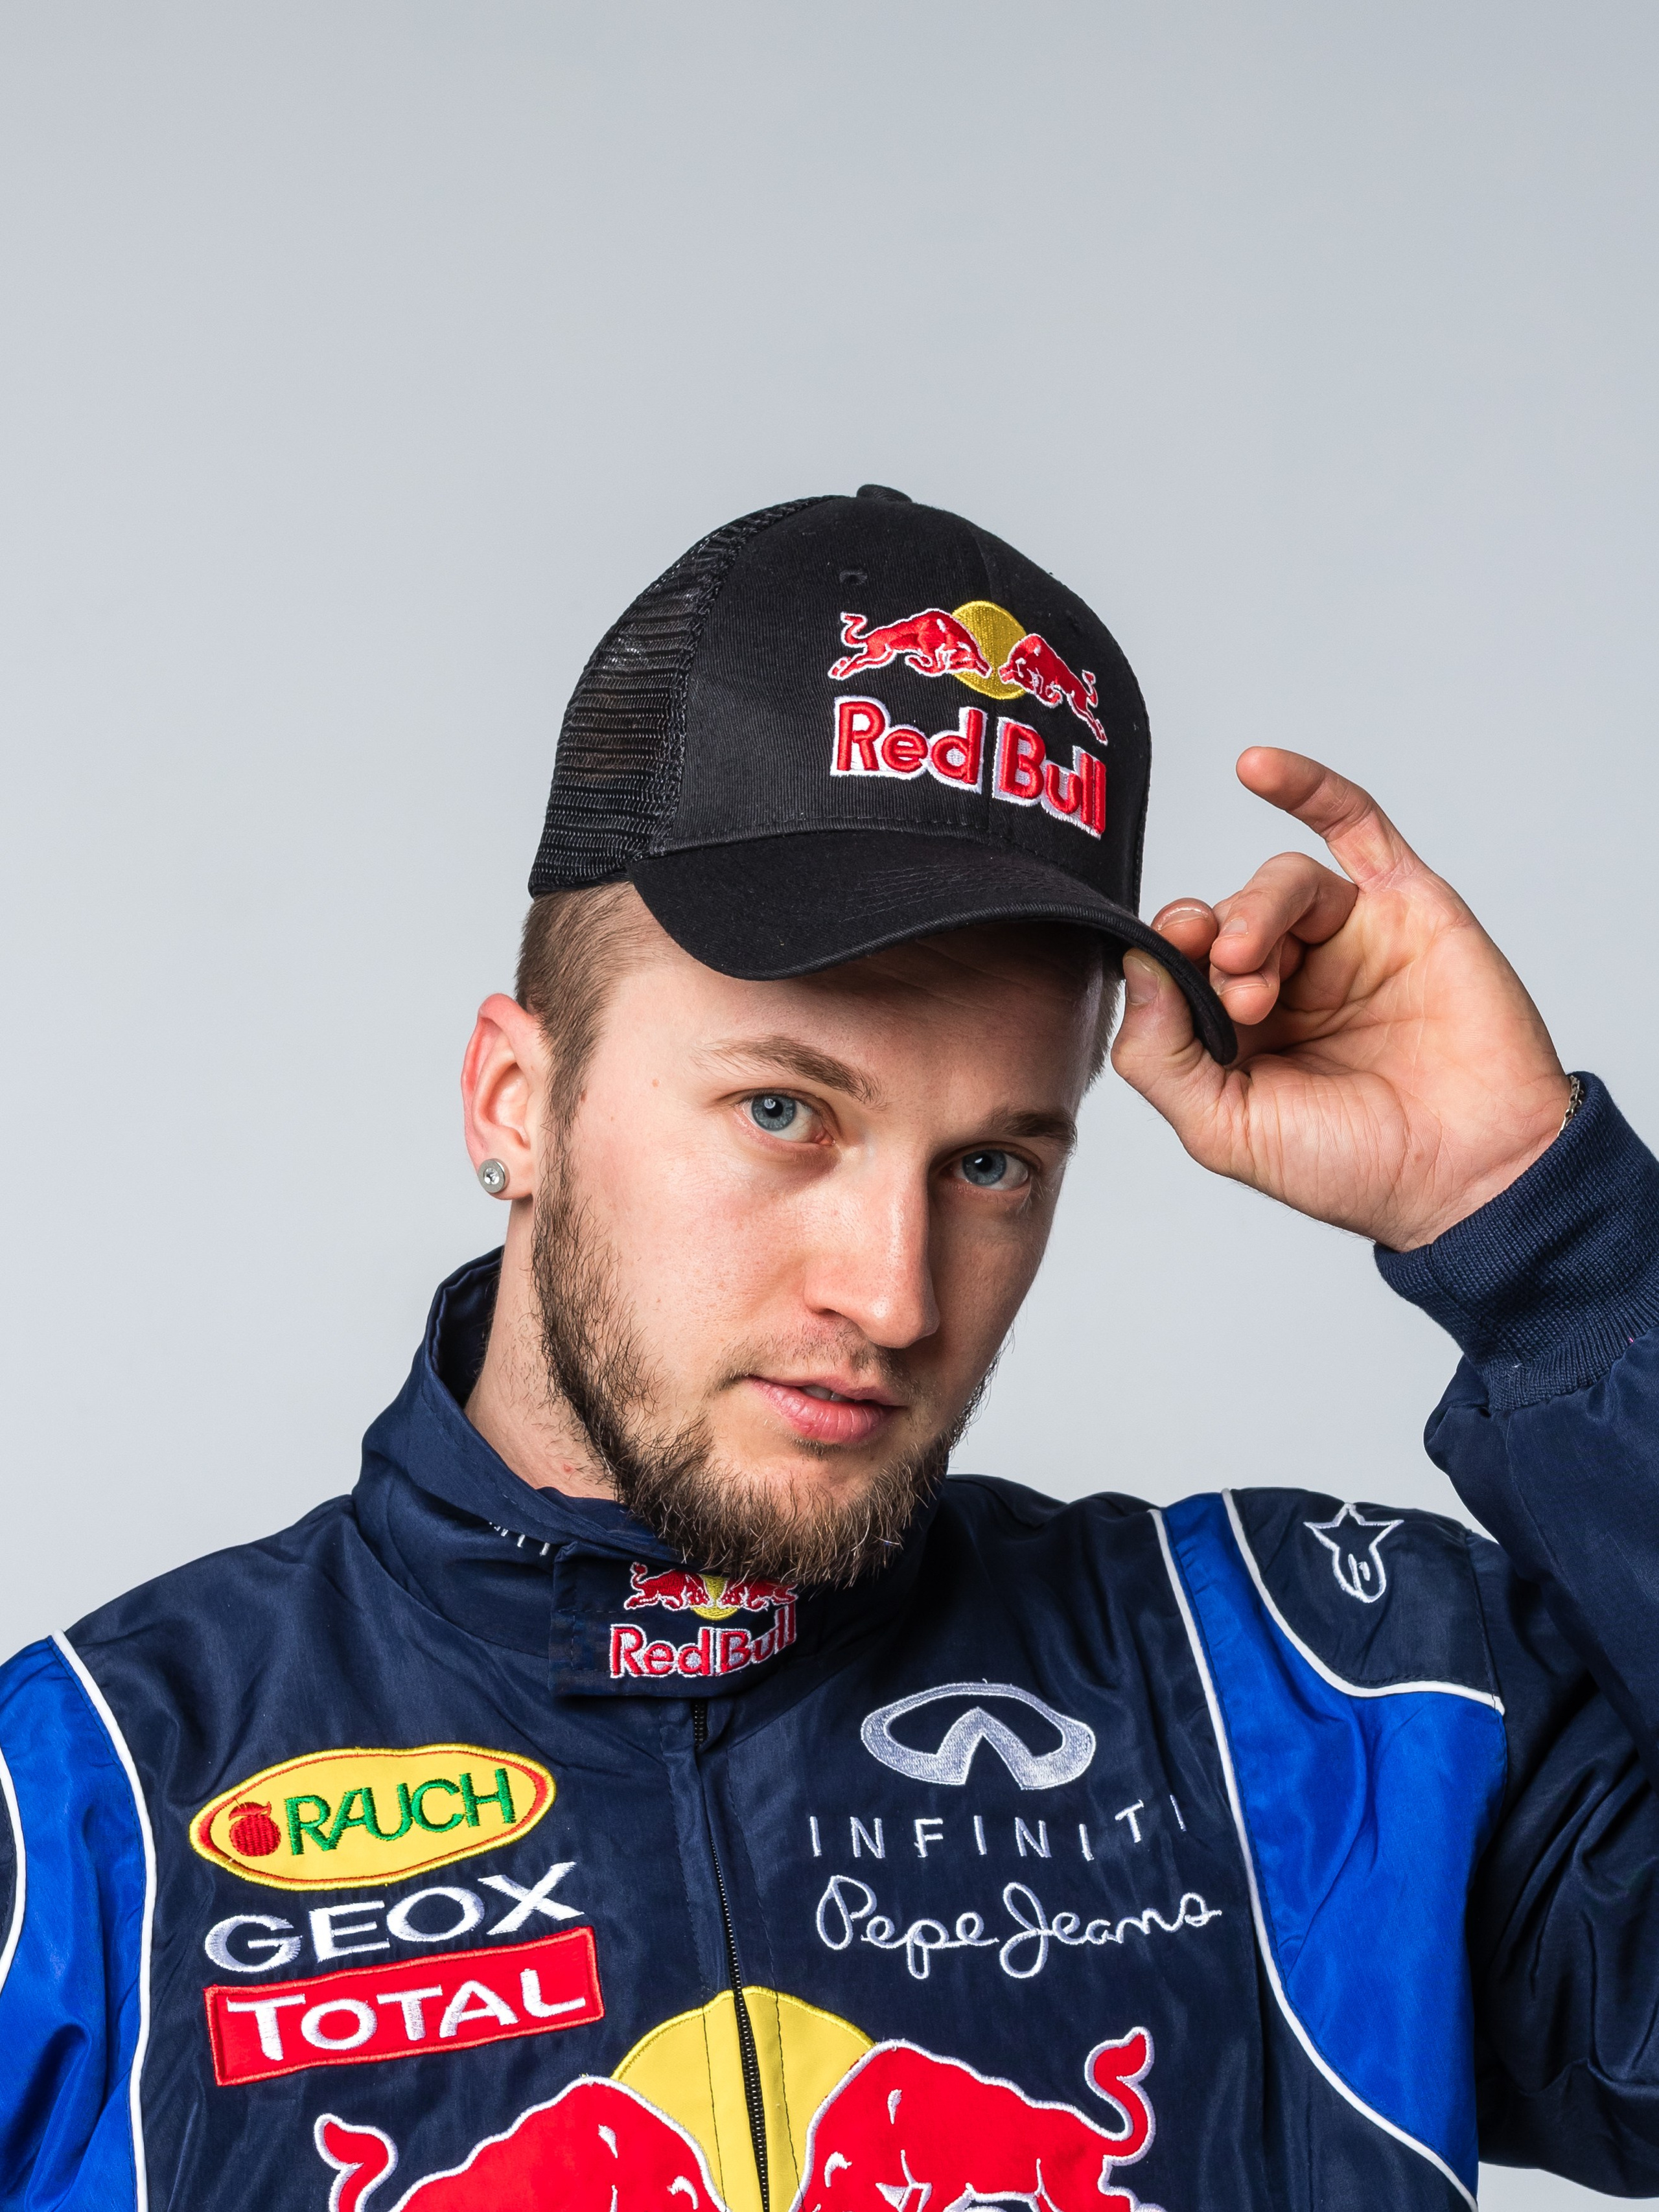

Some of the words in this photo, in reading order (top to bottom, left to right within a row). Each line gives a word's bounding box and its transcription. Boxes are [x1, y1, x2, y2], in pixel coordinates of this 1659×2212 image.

[831, 696, 988, 794] Red
[992, 717, 1107, 840] Bull
[610, 1623, 714, 1678] Red
[714, 1603, 796, 1677] Bull
[284, 1768, 517, 1856] RAUCH
[809, 1794, 1187, 1861] INFINITI
[204, 1861, 585, 1973] GEOX
[816, 1875, 999, 1979] Pepe
[999, 1882, 1222, 1979] Jeans
[226, 1968, 586, 2062] TOTAL
